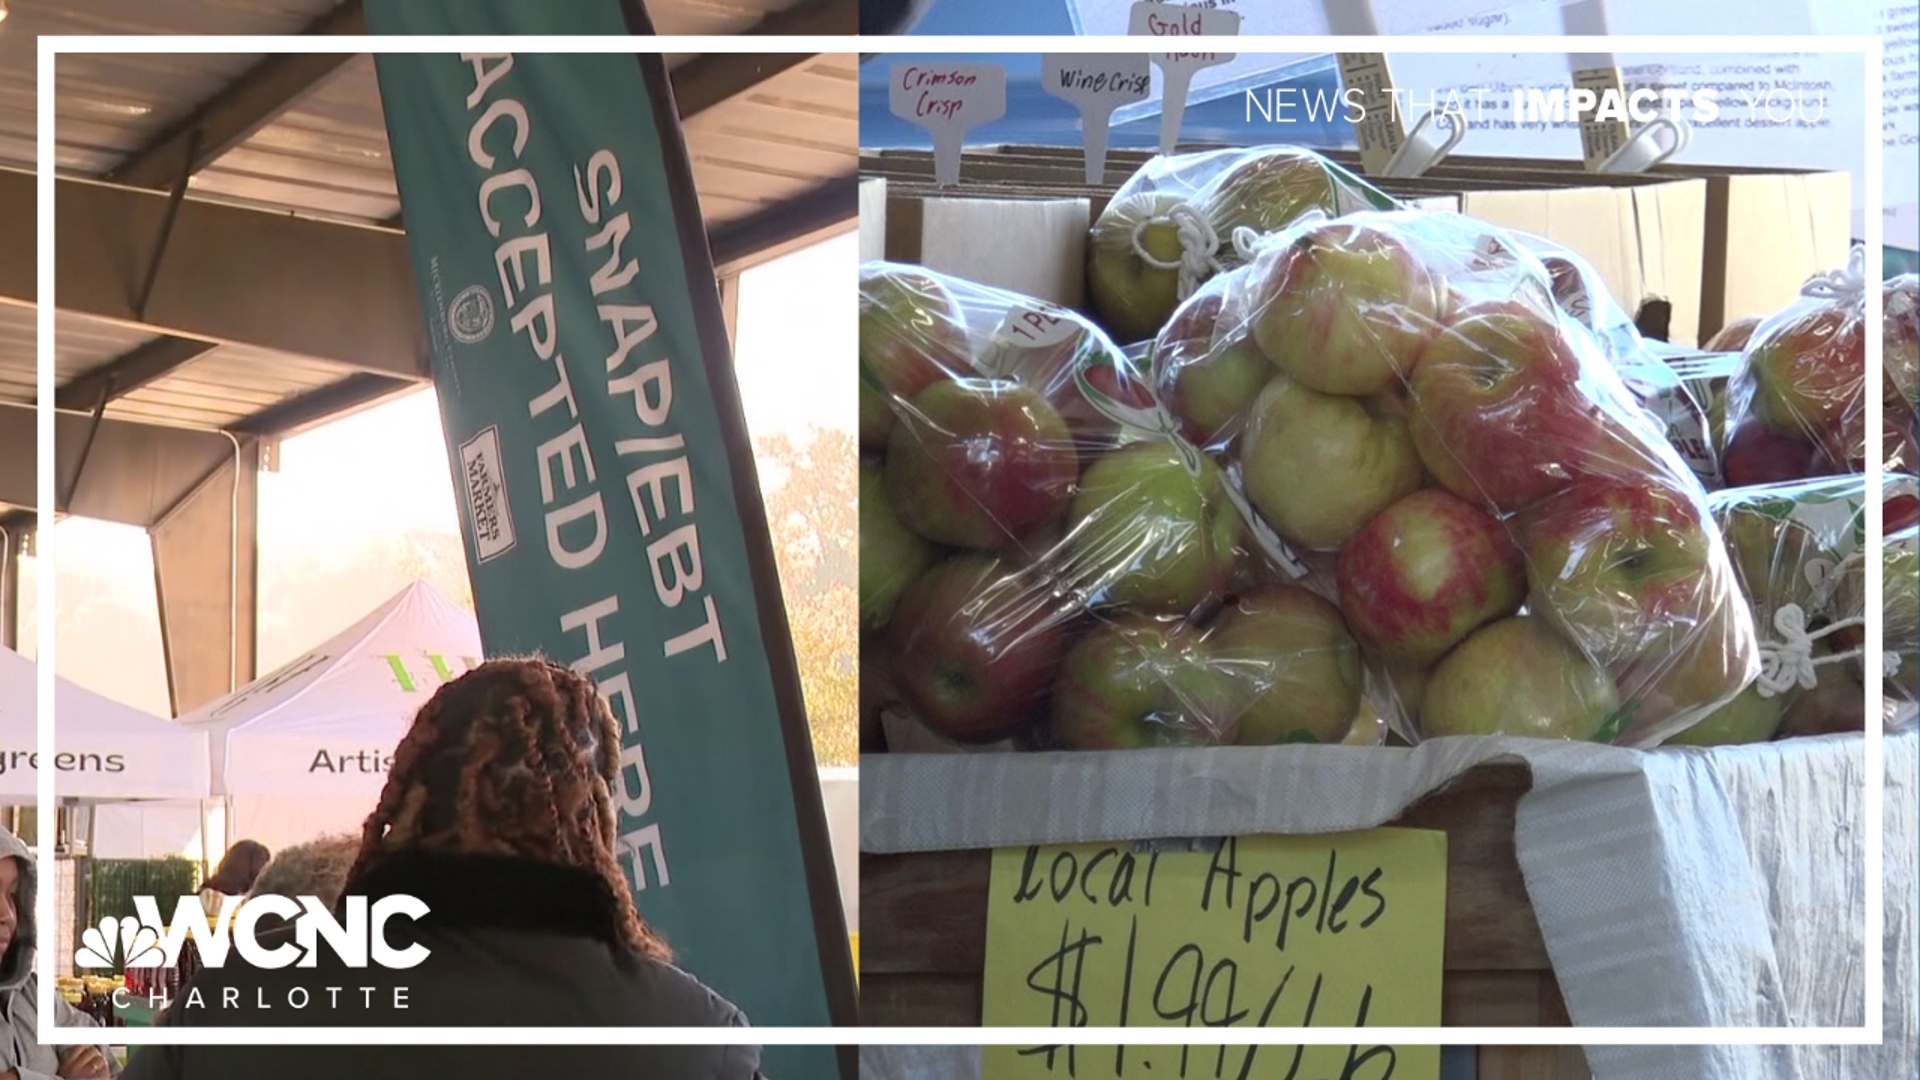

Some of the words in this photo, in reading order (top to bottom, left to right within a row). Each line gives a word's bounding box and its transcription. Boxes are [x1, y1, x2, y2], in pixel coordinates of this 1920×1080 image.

[1148, 13, 1202, 36] Gold
[903, 67, 977, 90] Crimson
[916, 90, 963, 119] Crisp
[461, 53, 609, 569] ACCEPTED
[466, 459, 492, 542] MARKET
[476, 451, 500, 541] FARMERS
[1013, 846, 1159, 907] Local
[1200, 836, 1387, 951] Apples
